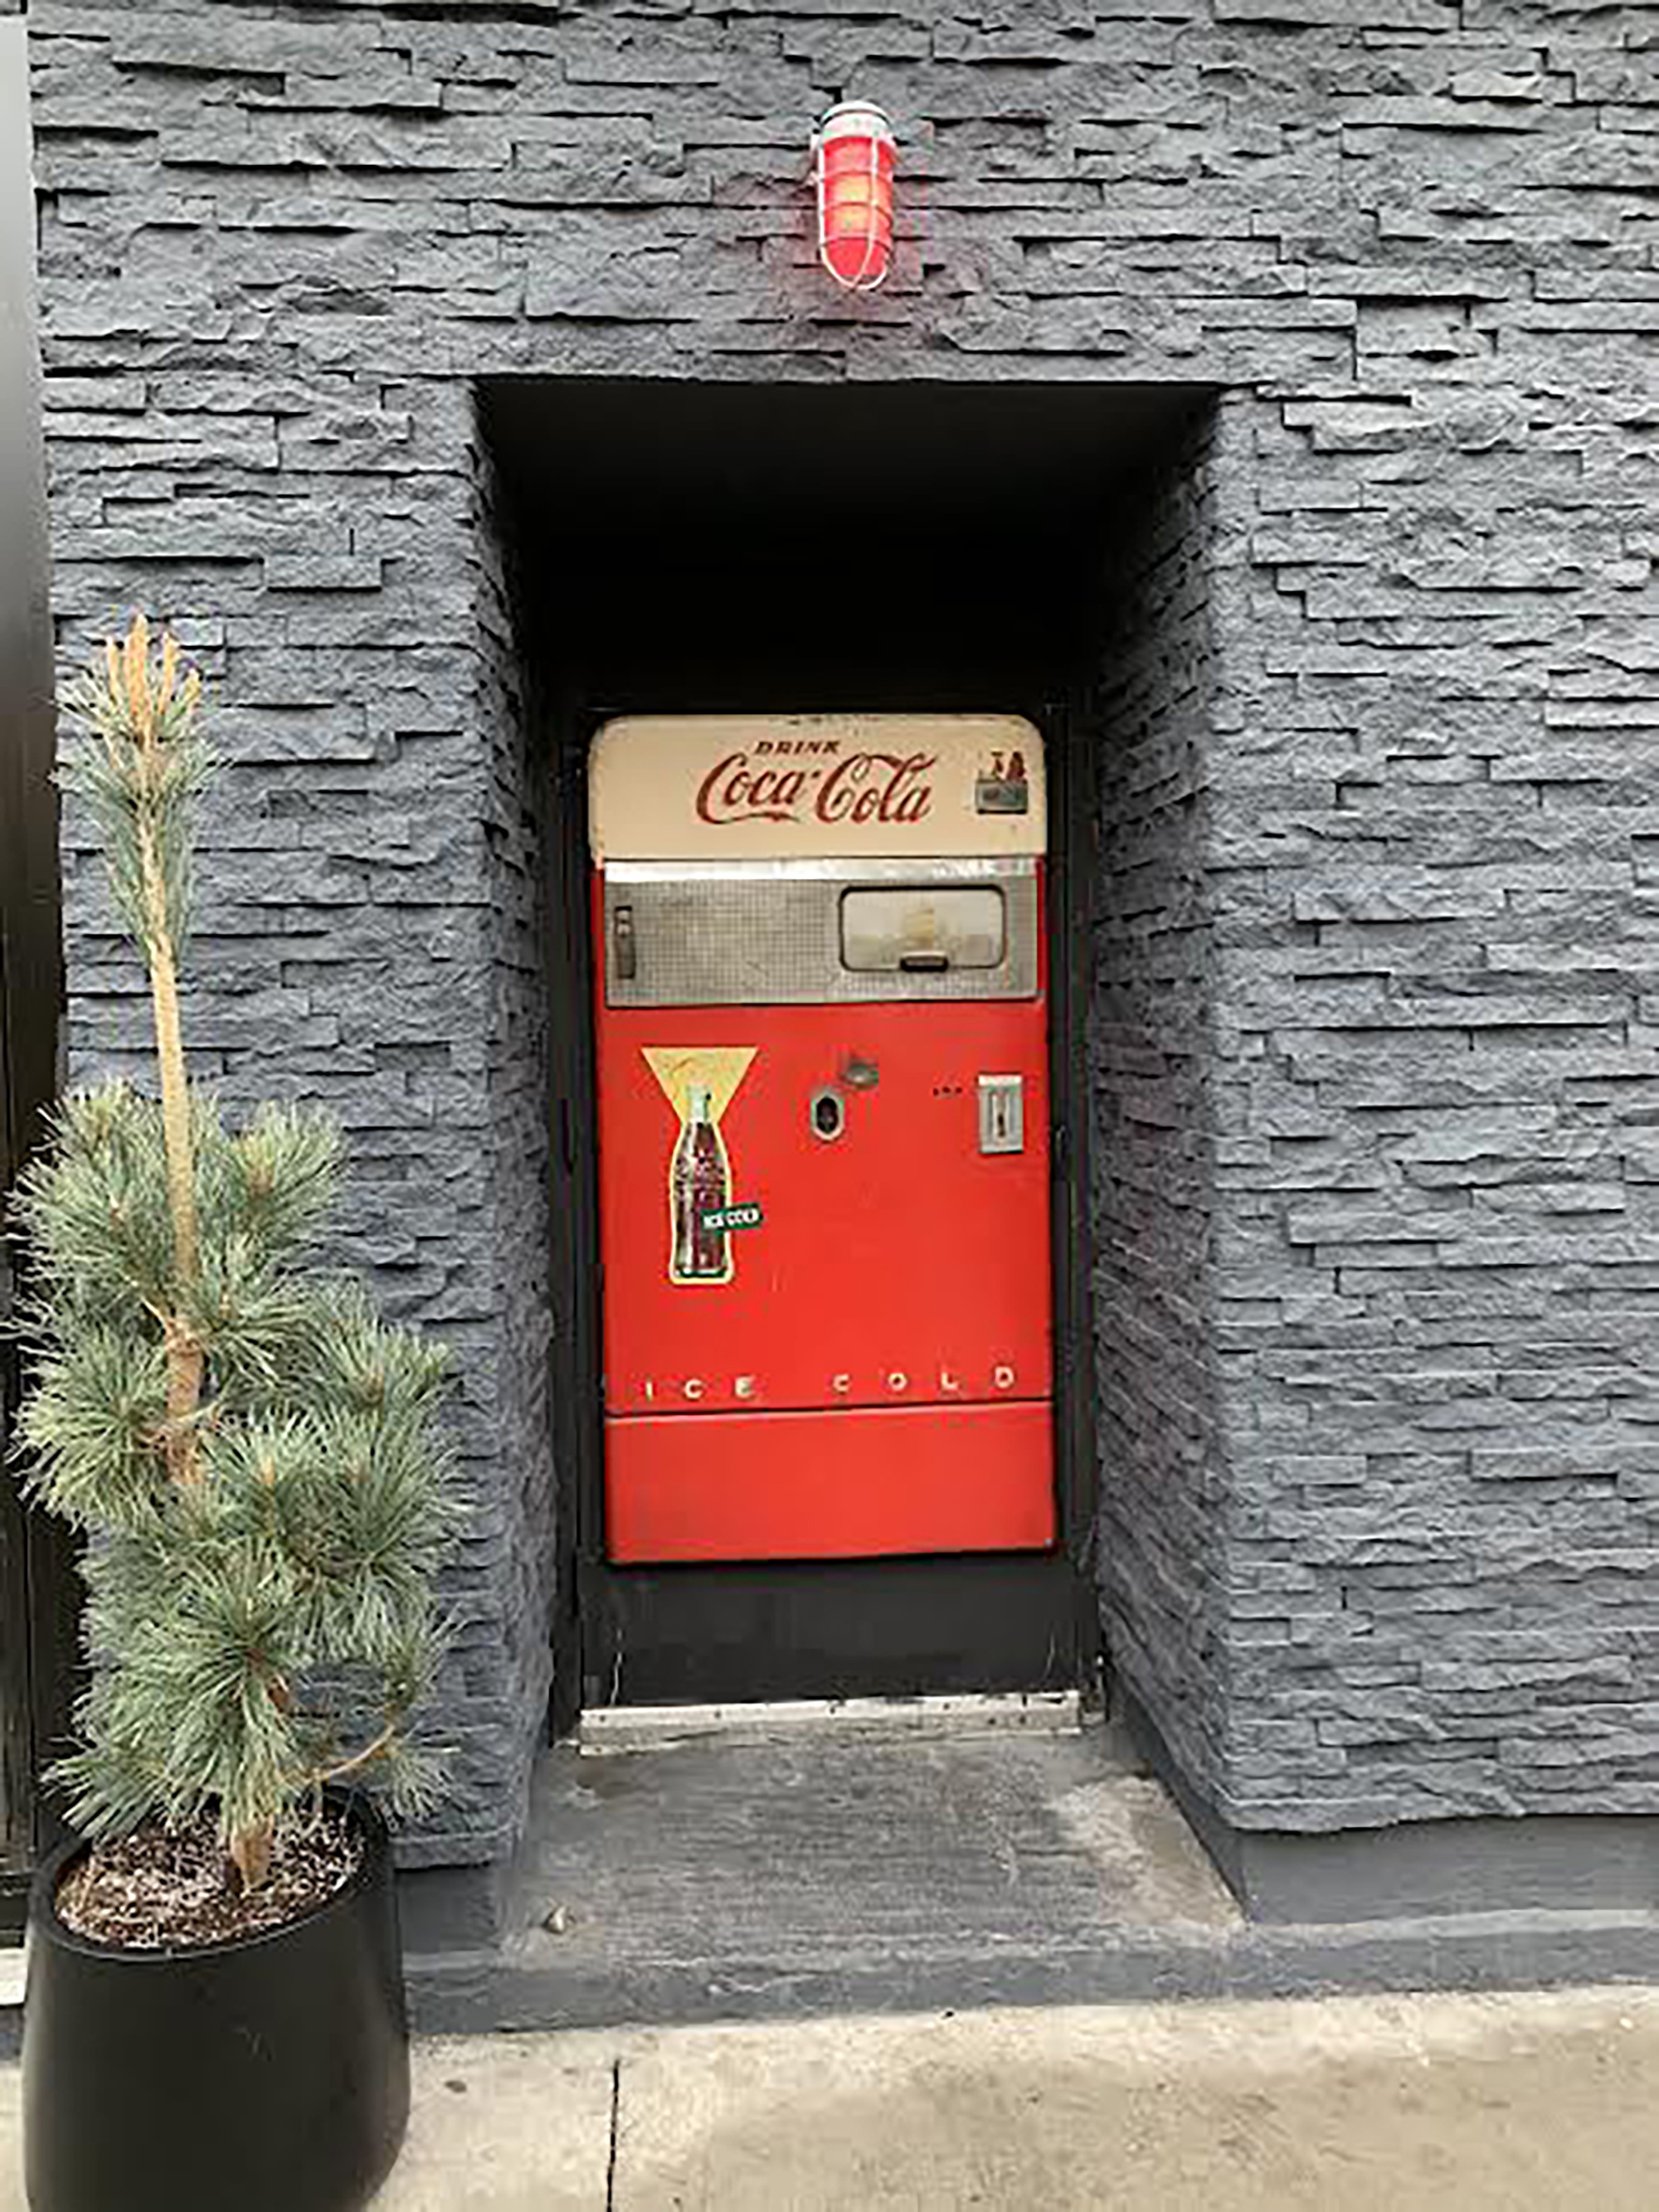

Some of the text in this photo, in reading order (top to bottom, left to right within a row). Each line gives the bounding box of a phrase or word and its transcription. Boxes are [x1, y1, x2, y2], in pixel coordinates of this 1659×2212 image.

[754, 741, 841, 755] DRINK
[645, 1365, 1014, 1402] ICE COLD
